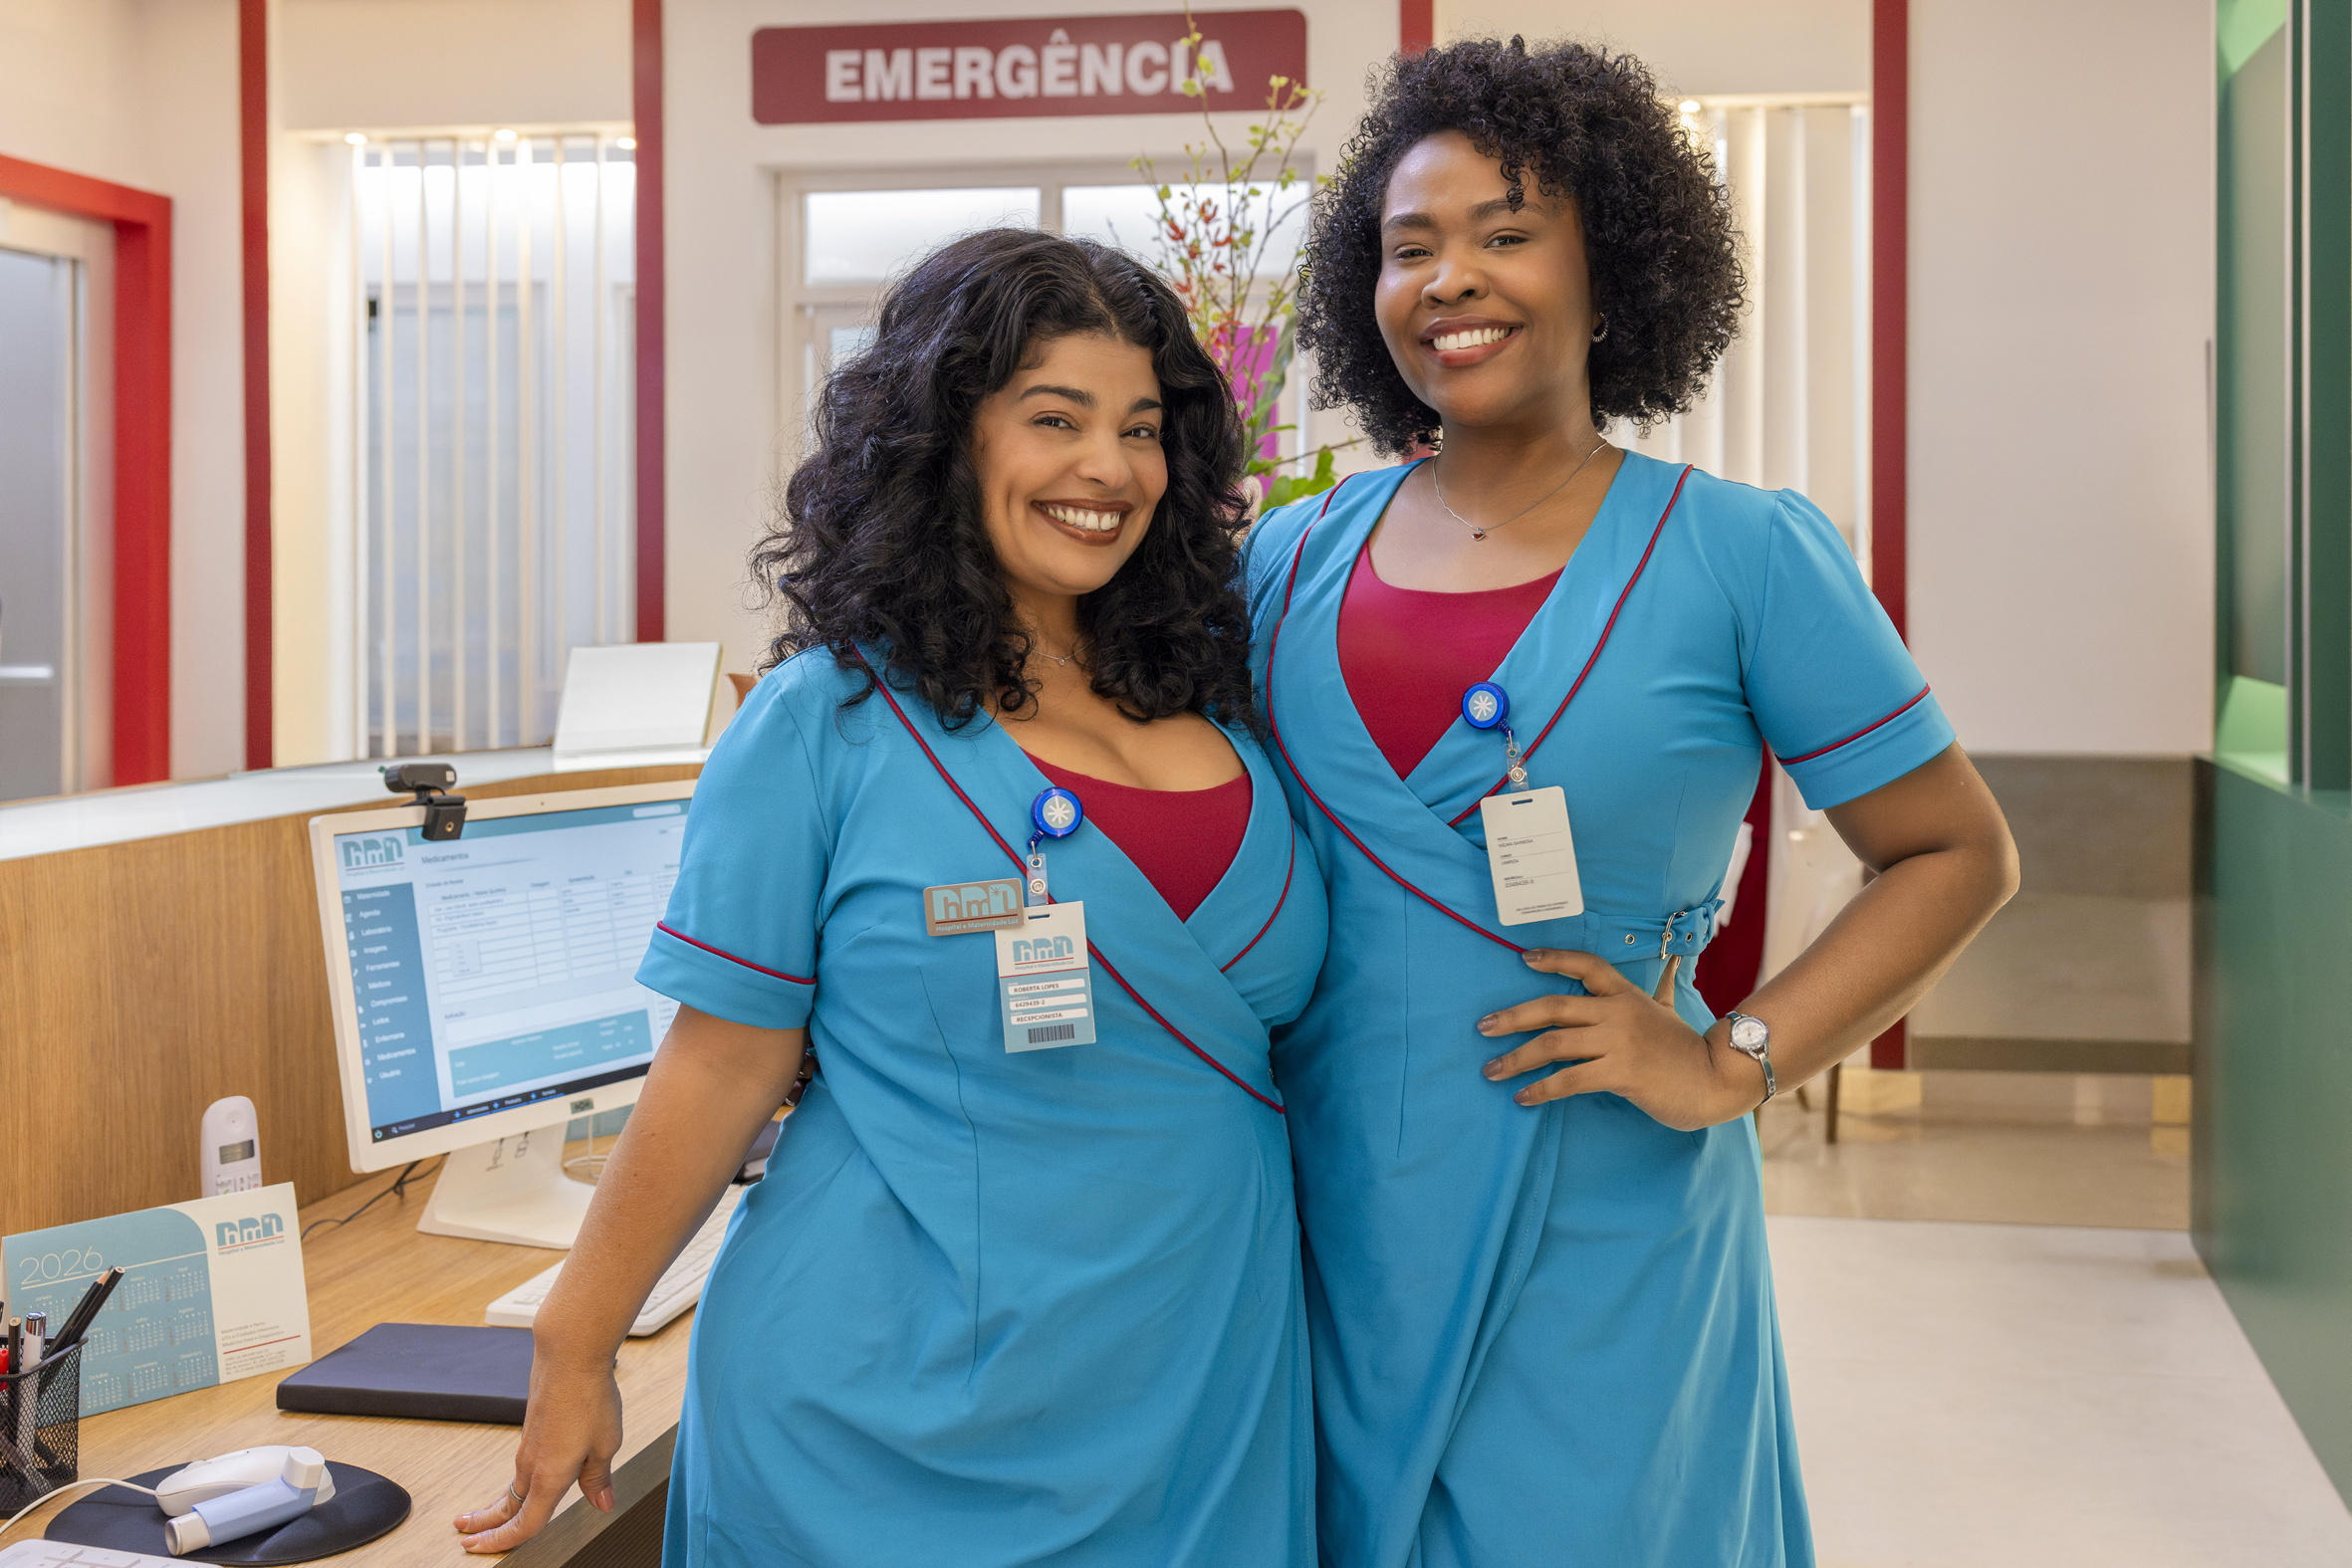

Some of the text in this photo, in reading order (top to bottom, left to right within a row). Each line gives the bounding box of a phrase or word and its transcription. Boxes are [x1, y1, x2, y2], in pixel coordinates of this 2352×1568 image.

[825, 28, 1234, 103] EMERGÊNCIA
[1017, 1012, 1063, 1022] RECEPCIONISTA
[20, 1245, 104, 1285] 2026
